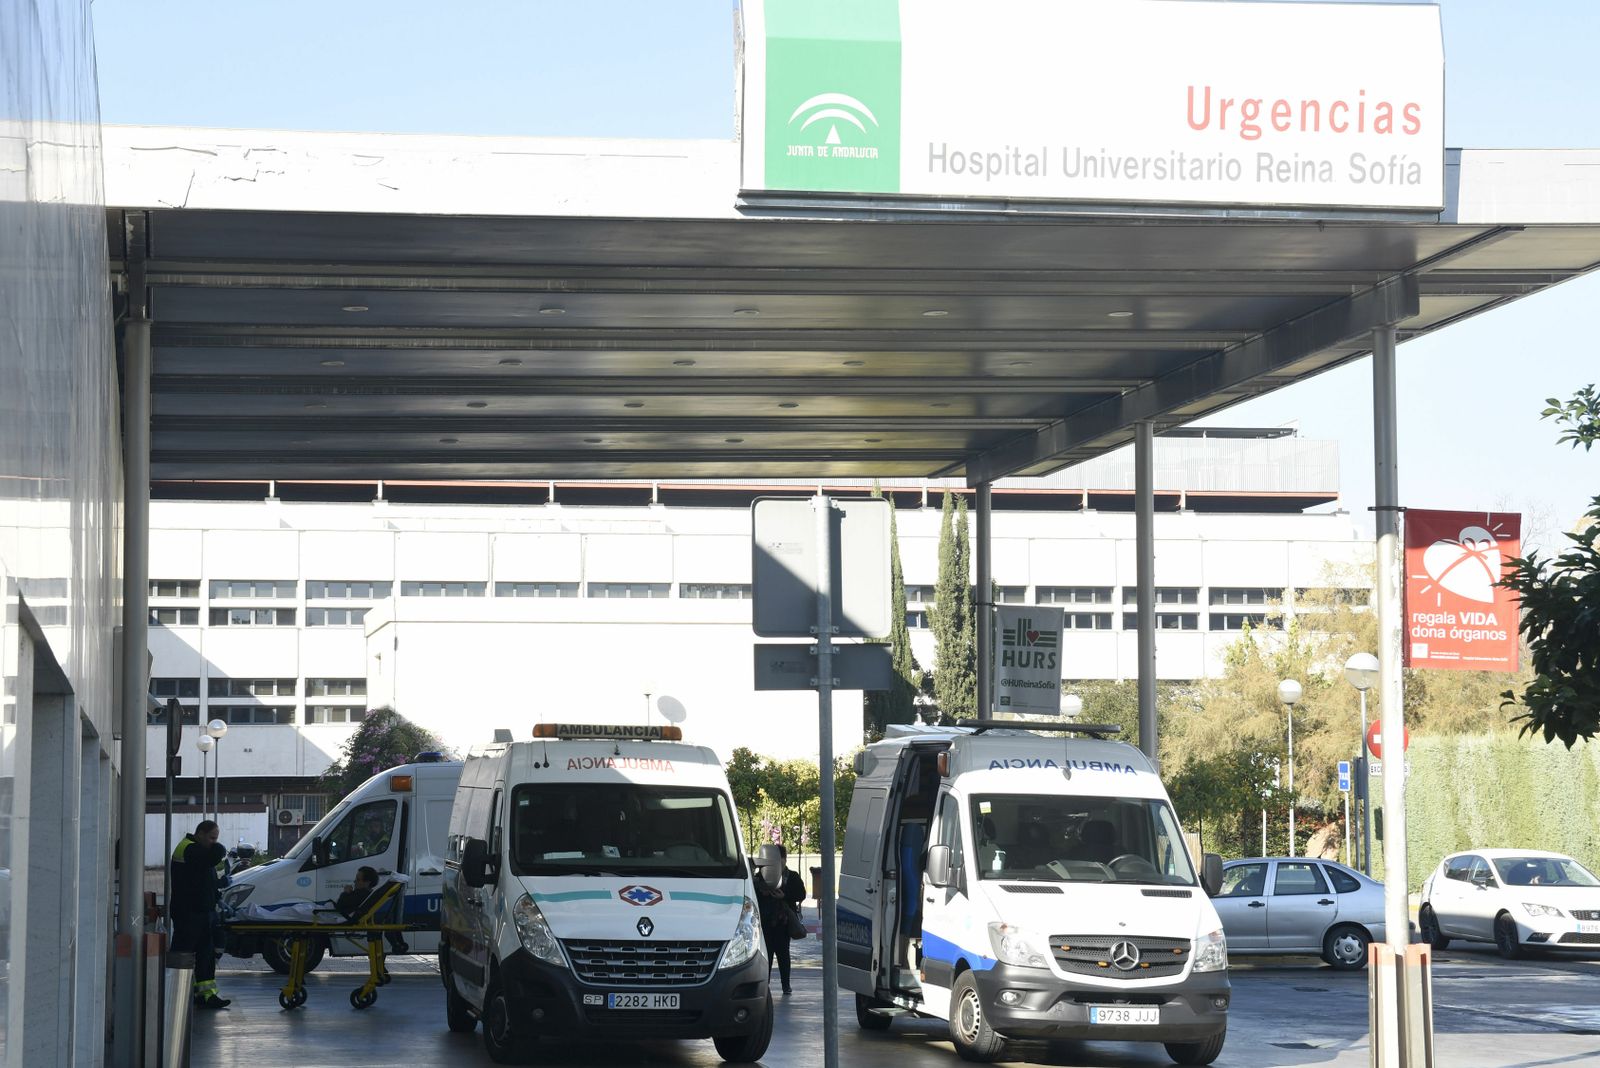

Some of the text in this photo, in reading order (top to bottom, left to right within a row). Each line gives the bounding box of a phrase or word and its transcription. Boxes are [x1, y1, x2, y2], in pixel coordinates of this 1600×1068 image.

[1187, 85, 1422, 141] Urgencias
[786, 145, 814, 156] JUNTA
[817, 146, 829, 157] DE
[928, 142, 1422, 185] Hospital Universitario Reina Sofía
[1412, 611, 1498, 626] regala VIDA
[1411, 625, 1507, 642] dona órganos
[1001, 649, 1056, 669] HURS
[559, 724, 660, 737] AMBULANCIA
[585, 995, 678, 1008] SP 2282 HKD
[1098, 1010, 1157, 1022] 9738 JJJ
